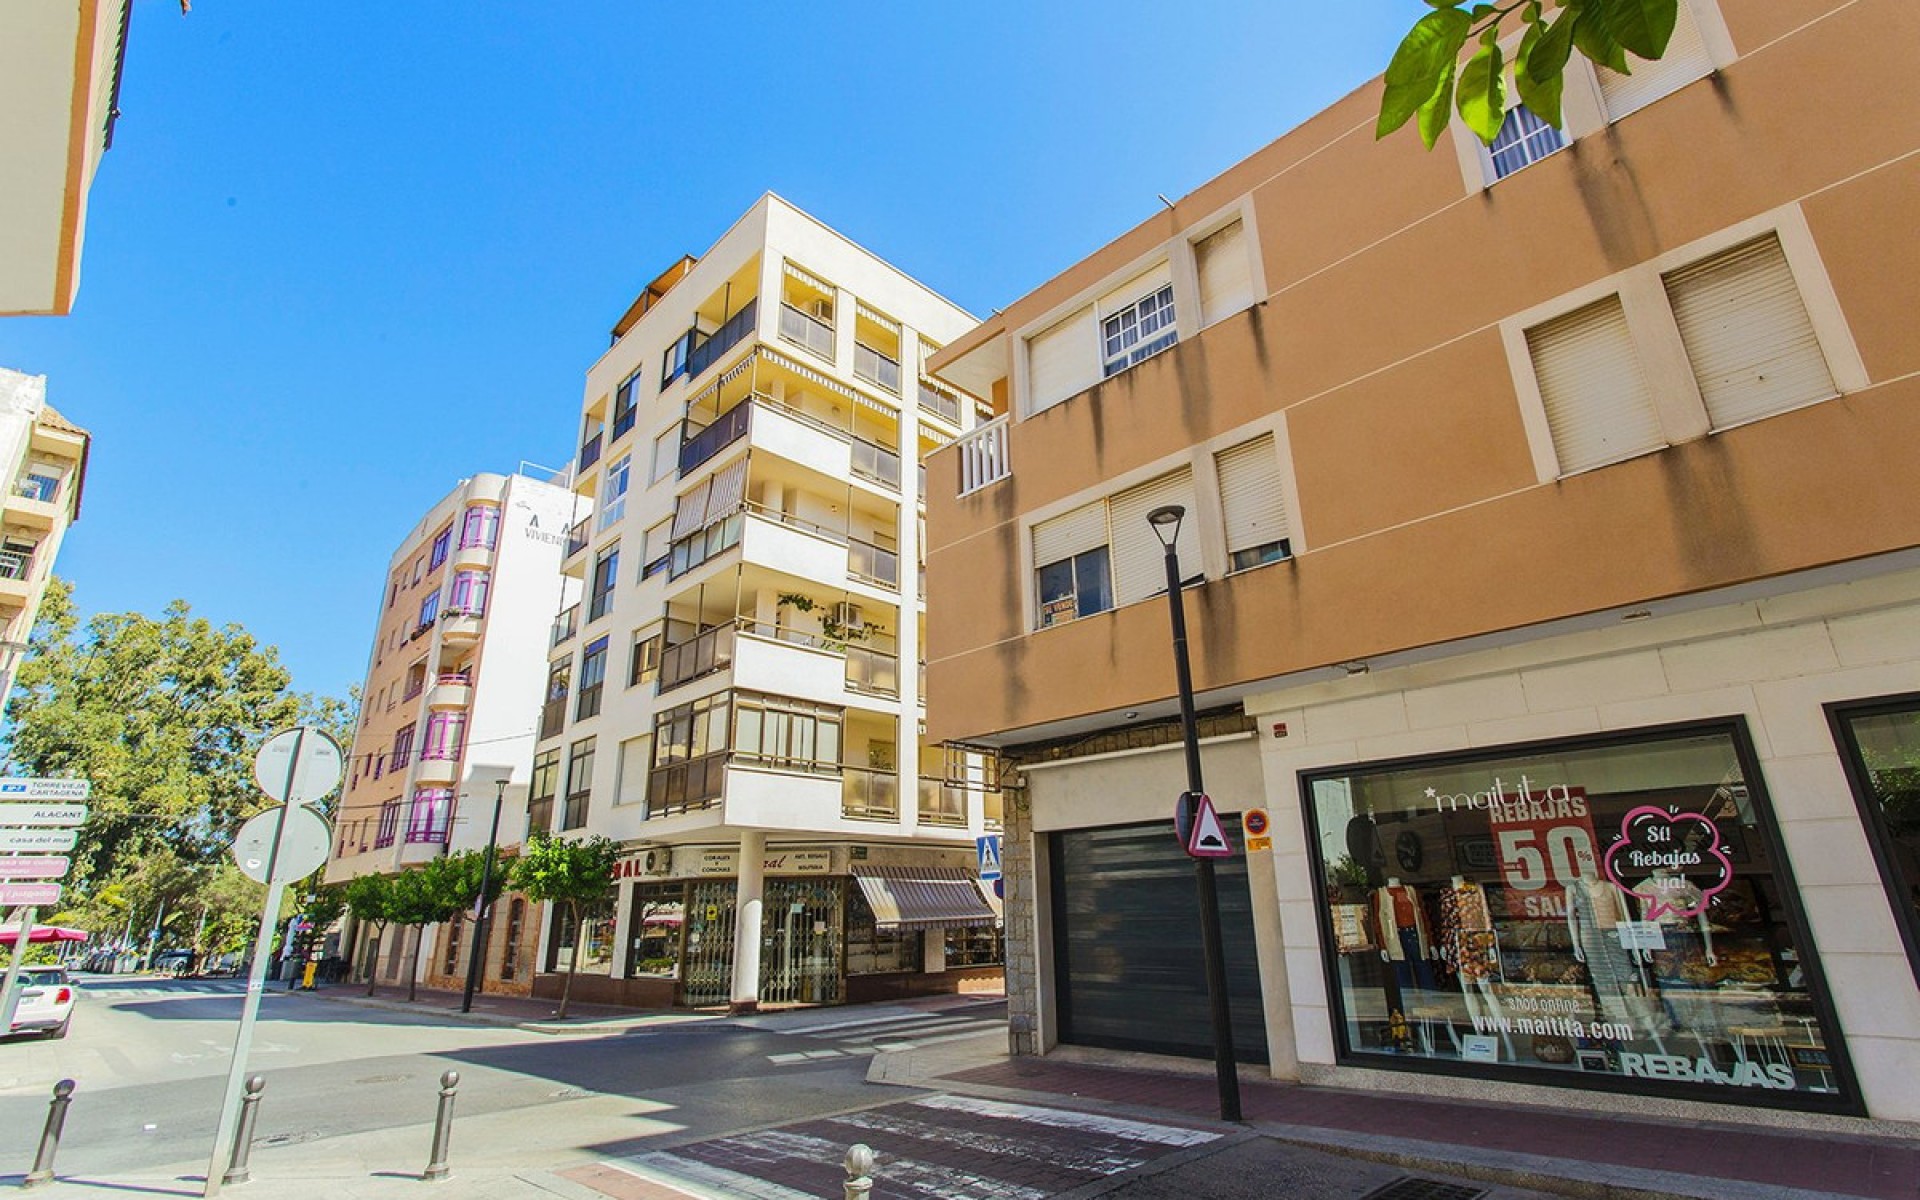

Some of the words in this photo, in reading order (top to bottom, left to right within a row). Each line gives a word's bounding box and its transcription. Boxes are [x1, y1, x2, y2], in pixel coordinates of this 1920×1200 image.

[33, 810, 82, 818] ALACANT
[1489, 796, 1588, 823] REBAJAS
[35, 836, 52, 844] del
[1629, 849, 1701, 869] Rebajas
[1524, 896, 1569, 918] SAL
[1471, 1015, 1634, 1041] www.maitita.com
[1619, 1052, 1797, 1091] REBAJAS
